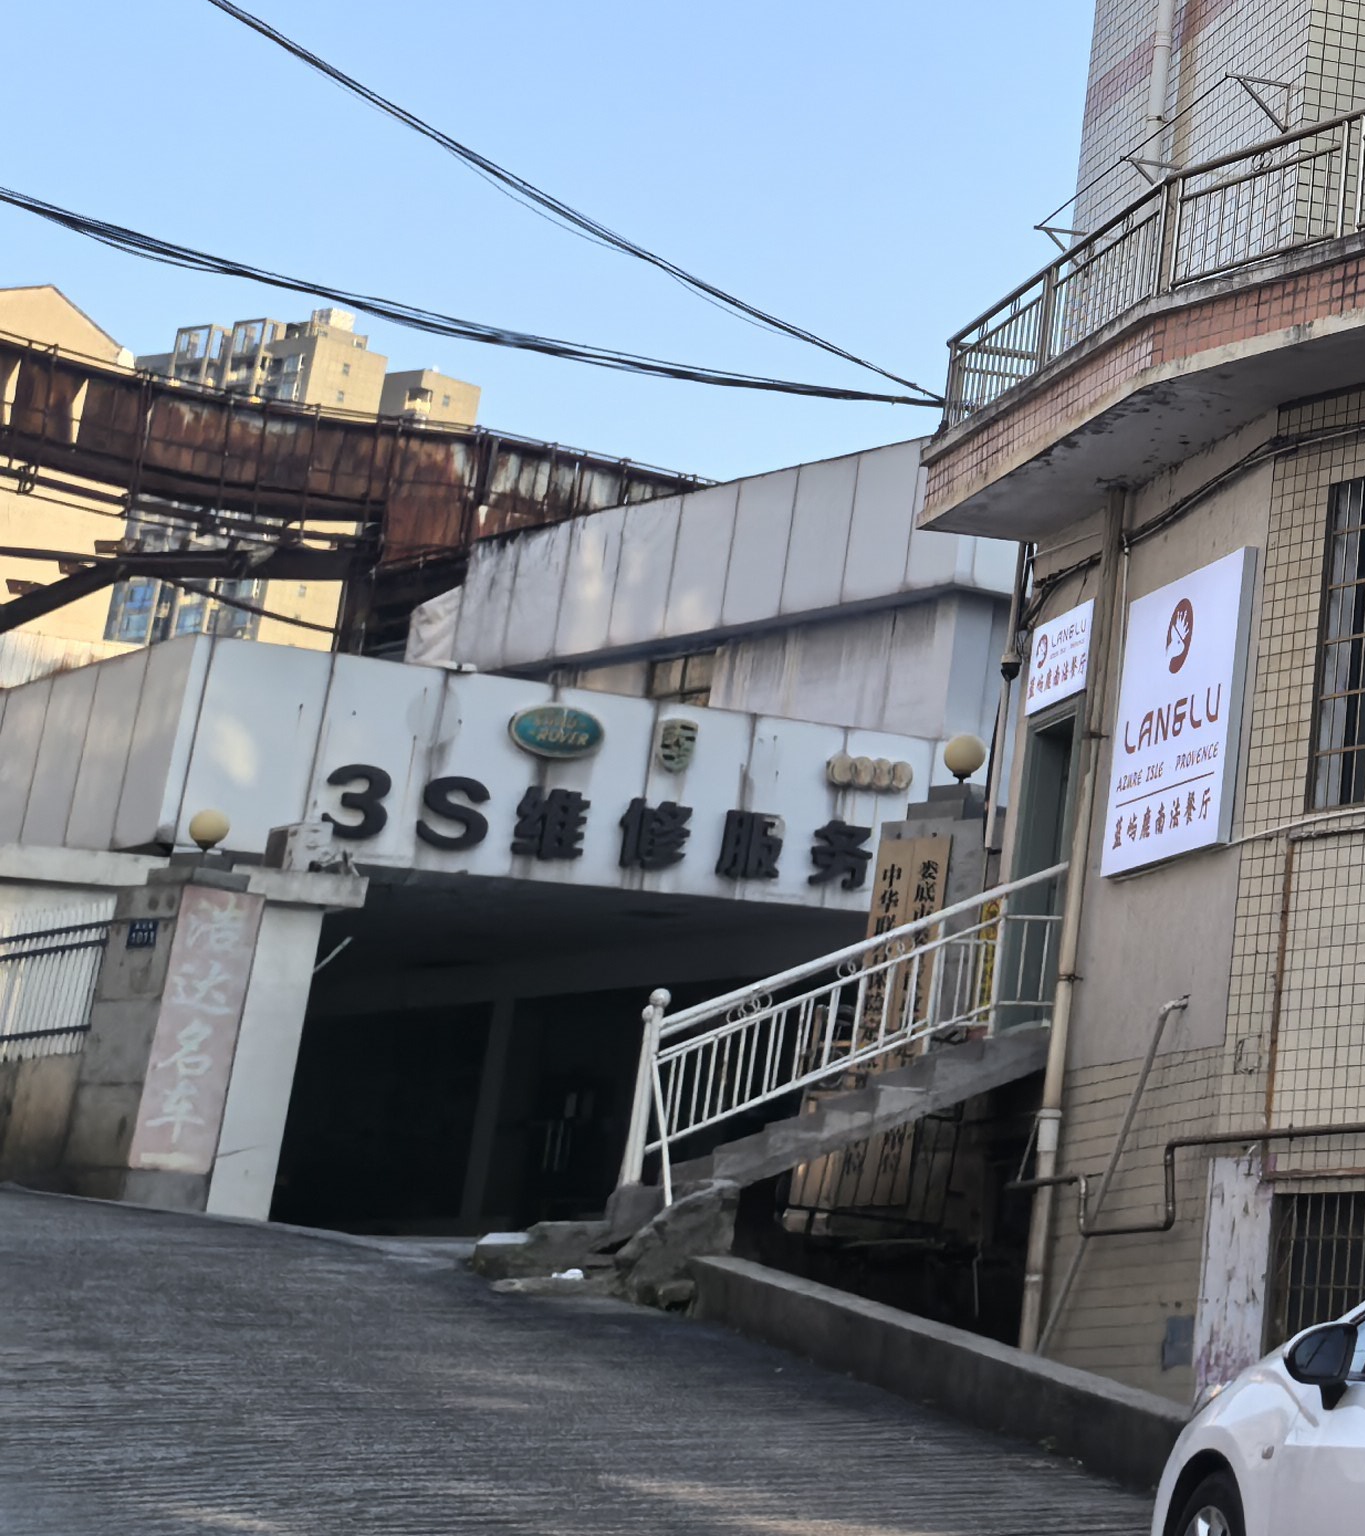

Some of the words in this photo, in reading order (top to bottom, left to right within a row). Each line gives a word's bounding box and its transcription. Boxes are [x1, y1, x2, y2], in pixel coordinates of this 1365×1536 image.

[1175, 741, 1220, 772] PROVENCE
[322, 763, 873, 890] 3S维修服务
[145, 896, 249, 1144] 浩达名车
